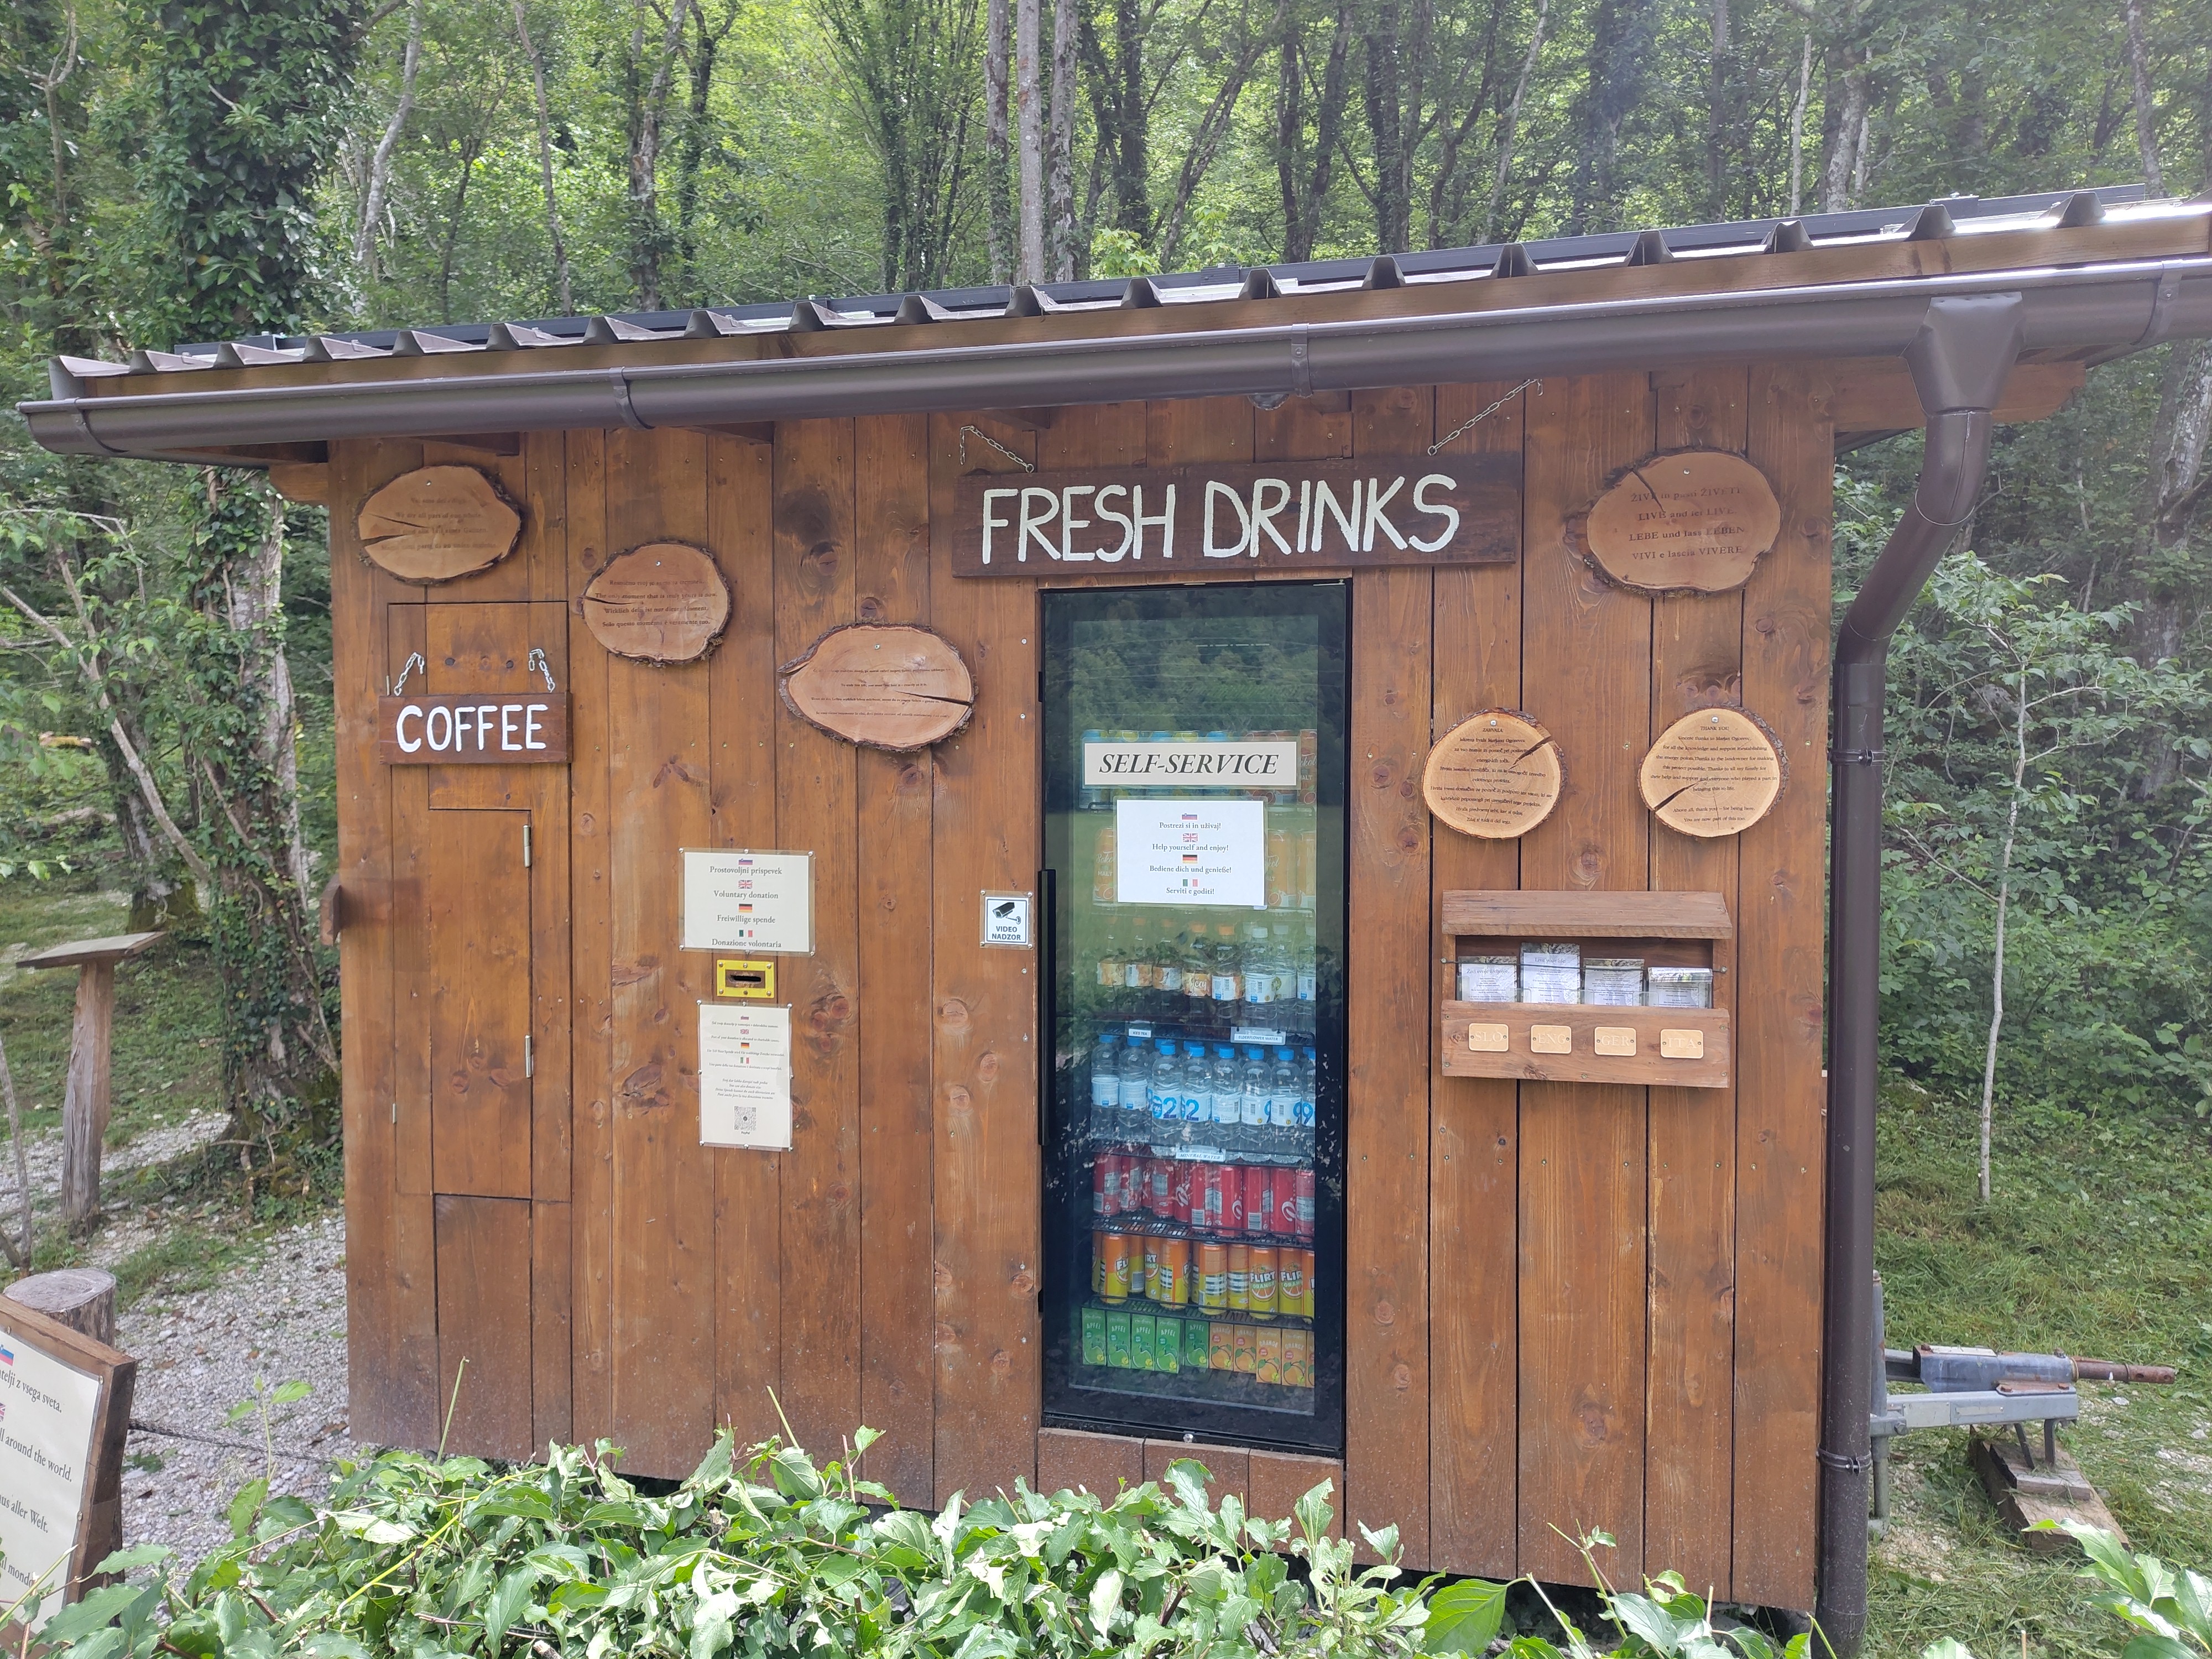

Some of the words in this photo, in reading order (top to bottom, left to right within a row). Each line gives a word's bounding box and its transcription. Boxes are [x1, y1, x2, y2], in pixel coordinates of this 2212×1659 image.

[982, 483, 1176, 564] FRESH
[1203, 474, 1460, 558] DRINKS
[1638, 511, 1666, 521] LIVE
[1670, 510, 1687, 518] and
[1629, 531, 1658, 541] LEBE
[1662, 529, 1681, 539] und
[1683, 529, 1702, 538] lass
[1706, 526, 1745, 536] LEBEN
[1632, 552, 1656, 561] VIVI
[1668, 549, 1695, 558] lascia
[1699, 546, 1743, 555] VIVERE
[396, 703, 549, 753] COFFEE
[1099, 753, 1279, 774] SELF-SERVICE
[1201, 822, 1221, 831] uživaj!
[1152, 844, 1168, 852] Help
[1169, 844, 1196, 852] yourself
[709, 866, 749, 876] Prostovoljni
[751, 868, 782, 877] prispevek
[1205, 866, 1232, 875] genieße!
[713, 890, 747, 900] Voluntary
[717, 915, 752, 925] Freiwillige
[753, 916, 775, 925] spende
[1475, 1031, 1503, 1042] SLO
[1538, 1034, 1566, 1045] ENG
[1600, 1035, 1630, 1046] GER
[1667, 1037, 1698, 1048] ITA
[1250, 1271, 1275, 1283] FLIRT
[1161, 1329, 1176, 1337] APFEL
[0, 1369, 15, 1389] telji
[17, 1379, 20, 1389] z
[22, 1381, 41, 1403] vsega
[42, 1394, 62, 1413] sveta.
[6, 1436, 33, 1458] around
[34, 1449, 46, 1467] the
[48, 1459, 72, 1483] world.
[11, 1500, 28, 1520] aller
[30, 1509, 48, 1533] Welt.
